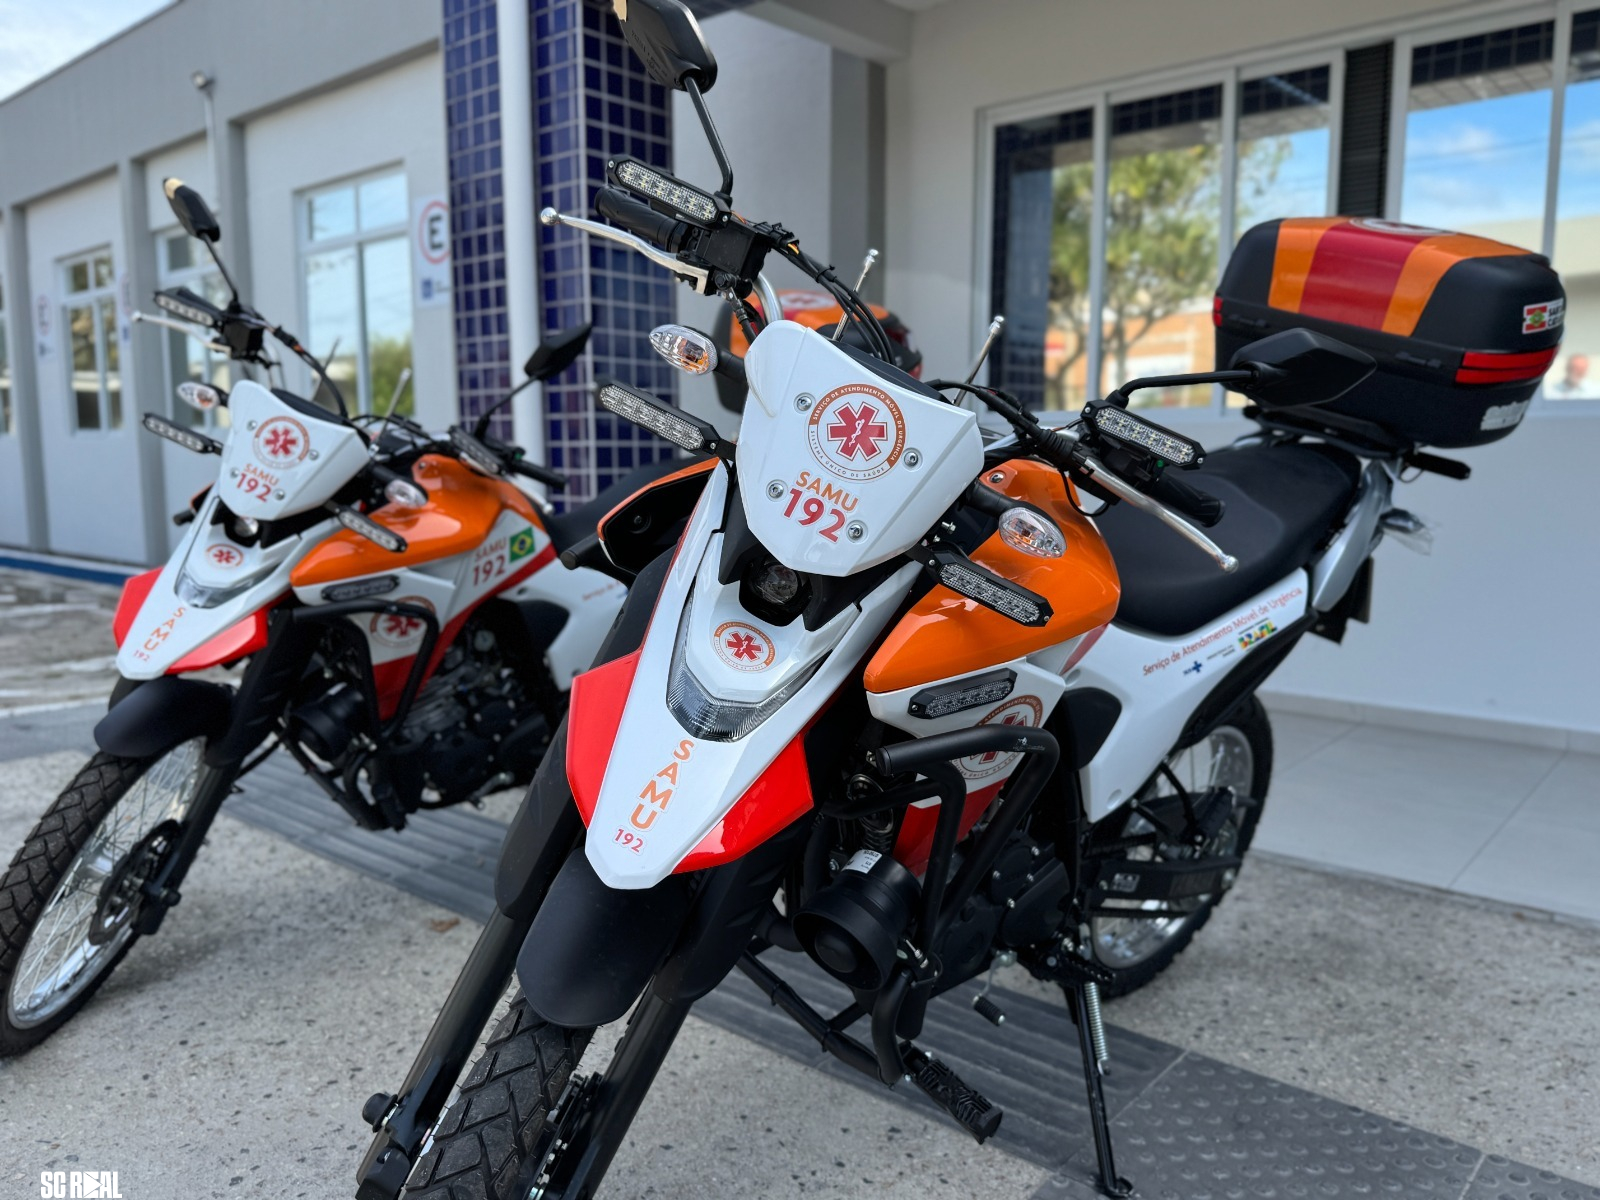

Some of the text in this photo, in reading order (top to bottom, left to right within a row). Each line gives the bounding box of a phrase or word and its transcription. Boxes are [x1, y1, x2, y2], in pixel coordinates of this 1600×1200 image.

[428, 213, 443, 250] E
[840, 386, 885, 399] ATENDIMENTO
[813, 398, 831, 420] SERVIÇO
[885, 399, 899, 419] MÓVEL
[810, 430, 824, 460] SISTEMA
[890, 430, 903, 461] URGÊNCIA
[236, 472, 272, 502] 192
[244, 463, 279, 486] SAMU
[795, 471, 859, 512] SAMU
[783, 488, 846, 543] 192
[475, 536, 507, 561] SAMU
[473, 554, 506, 587] 192
[144, 607, 186, 651] SAMU
[1142, 656, 1170, 676] Serviço
[1171, 651, 1181, 662] de
[1182, 625, 1233, 657] Atendimento
[1232, 611, 1258, 630] Móvel
[1257, 604, 1269, 615] de
[1269, 587, 1303, 611] Urgência
[630, 739, 695, 829] SAMU
[615, 828, 644, 853] 192
